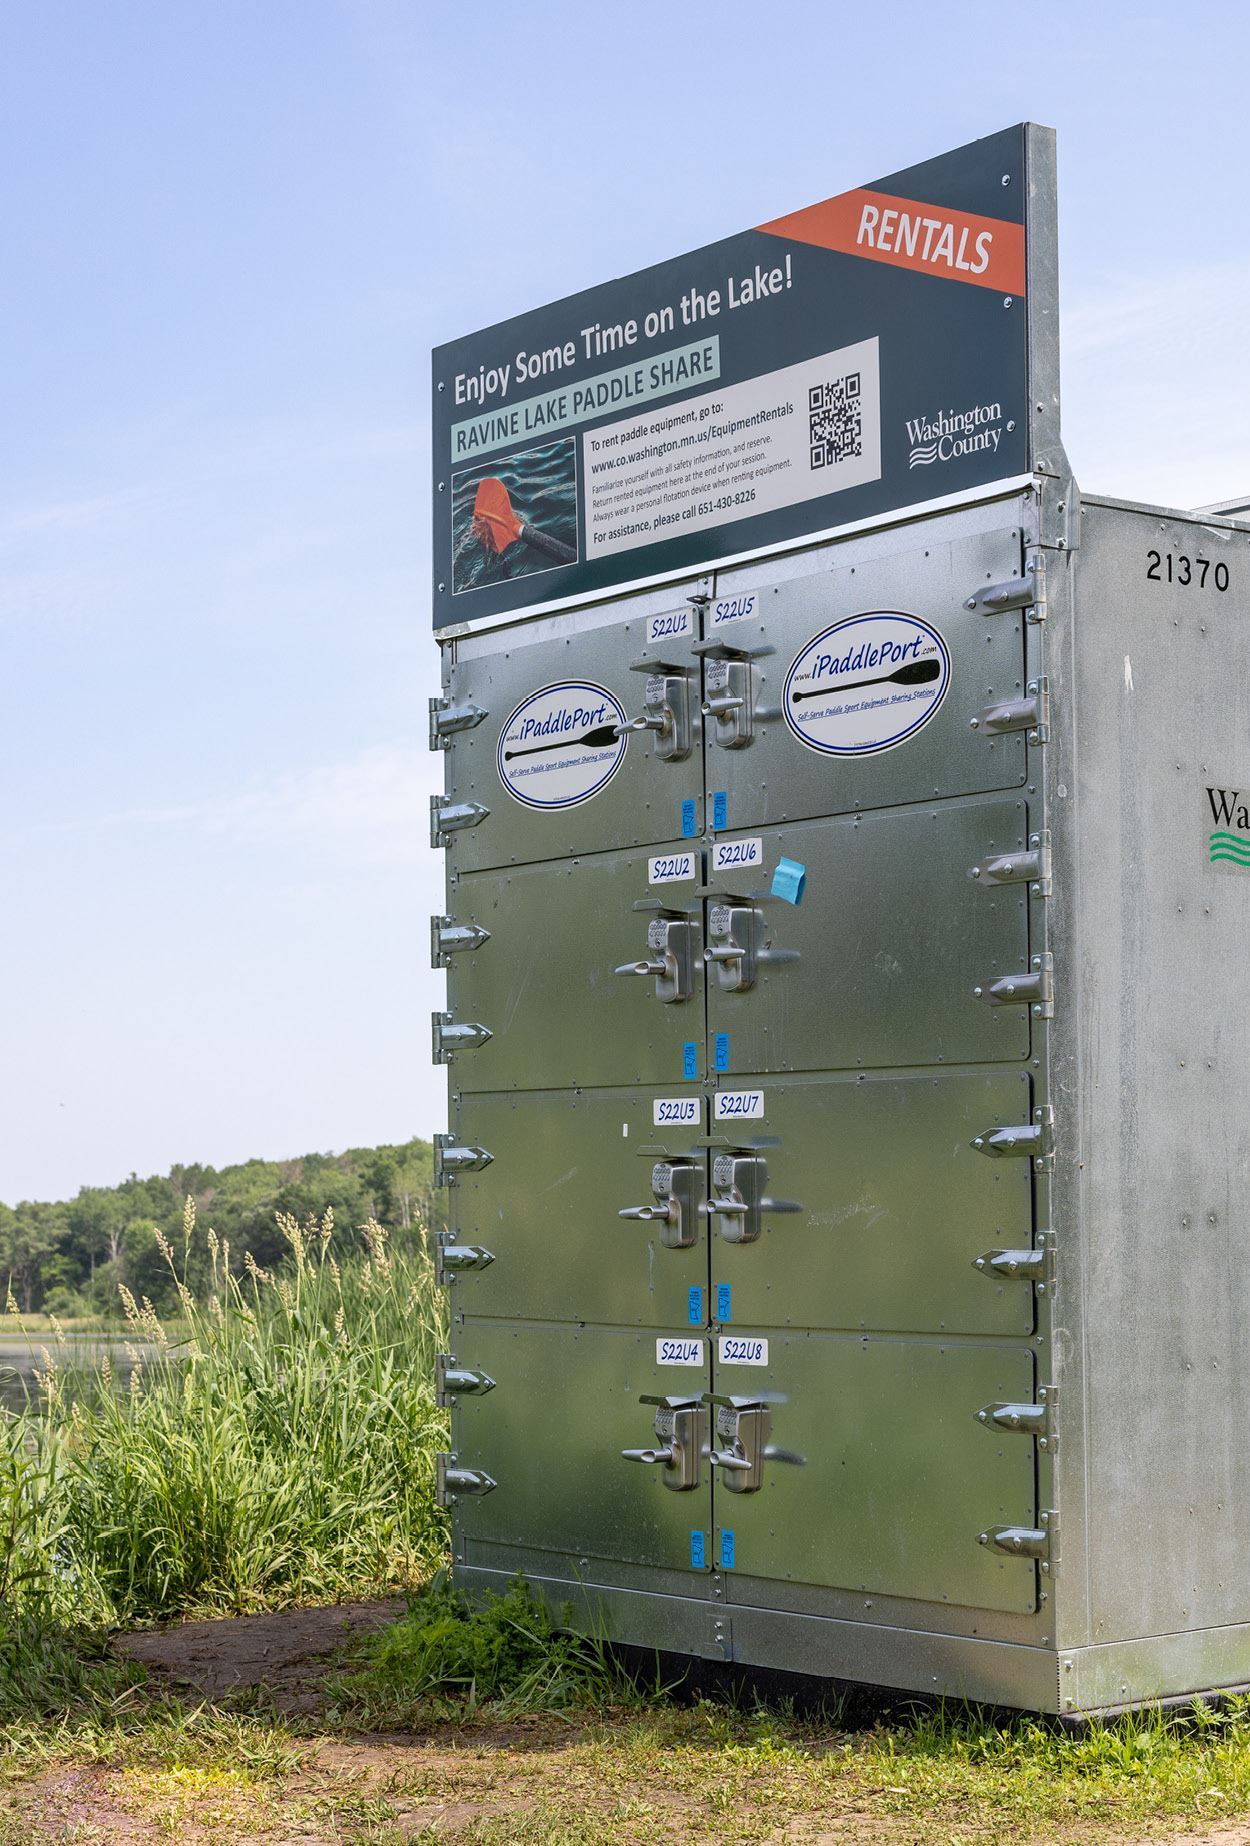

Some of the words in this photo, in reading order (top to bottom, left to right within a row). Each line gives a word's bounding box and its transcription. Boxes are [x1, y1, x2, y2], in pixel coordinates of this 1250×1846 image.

[856, 204, 993, 274] RENTALS
[455, 365, 510, 405] Enjoy
[515, 342, 576, 383] Some
[580, 319, 638, 359] Time
[644, 306, 674, 337] on
[680, 288, 721, 325] the
[728, 254, 793, 309] Lake!
[457, 411, 519, 453] RAVINE
[525, 395, 568, 431] LAKE
[573, 369, 644, 415] PADDLE
[650, 346, 713, 389] SHARE
[591, 441, 601, 451] To
[602, 434, 619, 449] rent
[621, 425, 648, 445] paddle
[650, 410, 698, 434] equipment,
[700, 407, 710, 421] go
[712, 403, 724, 414] to:
[591, 402, 794, 474] www.co.washington.mn.us/EquipmentRentals
[906, 403, 1002, 446] Washington
[937, 427, 1002, 462] County
[592, 480, 624, 494] Familiarize
[624, 470, 649, 487] yourself
[650, 467, 663, 478] with
[665, 465, 673, 474] all
[674, 458, 692, 472] safety
[693, 448, 732, 465] information,
[733, 443, 746, 454] and
[747, 435, 773, 450] reserve.
[593, 496, 613, 508] Return
[614, 489, 634, 502] rented
[635, 480, 669, 498] equipment
[669, 475, 684, 486] here
[685, 474, 692, 482] at
[692, 468, 704, 479] the
[704, 464, 717, 476] end
[718, 462, 725, 472] of
[725, 459, 741, 472] your
[741, 452, 767, 465] session.
[593, 511, 614, 523] Always
[615, 507, 631, 517] wear
[636, 495, 663, 513] personal
[663, 488, 690, 503] flotation
[691, 483, 712, 496] device
[712, 477, 731, 489] when
[731, 470, 755, 486] renting
[755, 459, 793, 477] equipment.
[593, 532, 607, 544] For
[608, 520, 652, 540] assistance,
[653, 513, 681, 530] please
[682, 505, 697, 519] call
[698, 488, 756, 516] 651-430-8226
[1147, 550, 1229, 592] 21370
[652, 614, 688, 638] S22U1
[715, 597, 755, 622] S22U5
[798, 711, 824, 722] Self-Serve
[825, 707, 843, 716] Paddle
[844, 702, 860, 713] Sport
[860, 696, 890, 710] Equipment
[890, 692, 912, 703] Sharing
[913, 688, 936, 700] Stations
[653, 857, 690, 879] S22U2
[718, 843, 757, 865] S22U6
[658, 1103, 695, 1121] S22U3
[719, 1095, 759, 1114] S22U7
[661, 1343, 698, 1361] S22U4
[724, 1341, 762, 1360] S22U8
